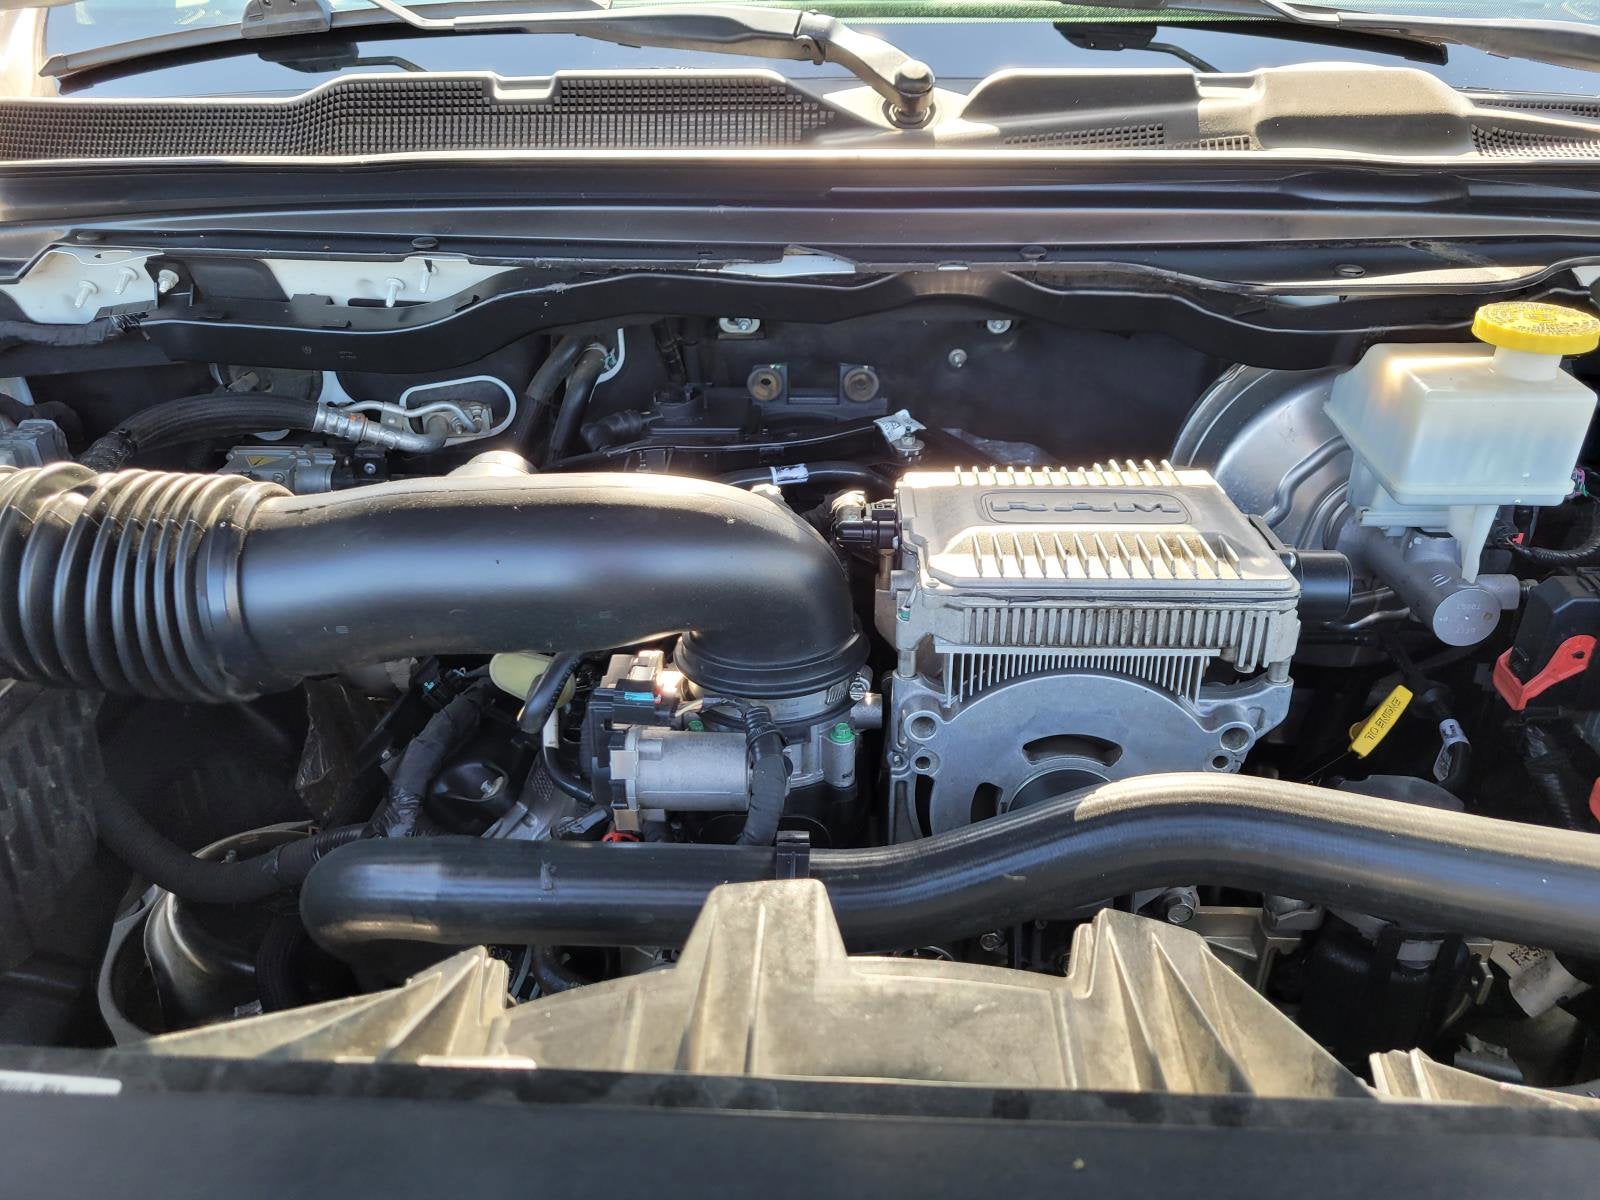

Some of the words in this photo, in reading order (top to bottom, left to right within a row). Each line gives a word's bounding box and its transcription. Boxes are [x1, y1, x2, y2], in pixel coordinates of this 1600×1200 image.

[989, 499, 1181, 513] RAM
[1375, 696, 1401, 728] ENGINE
[1364, 726, 1379, 742] OIL
